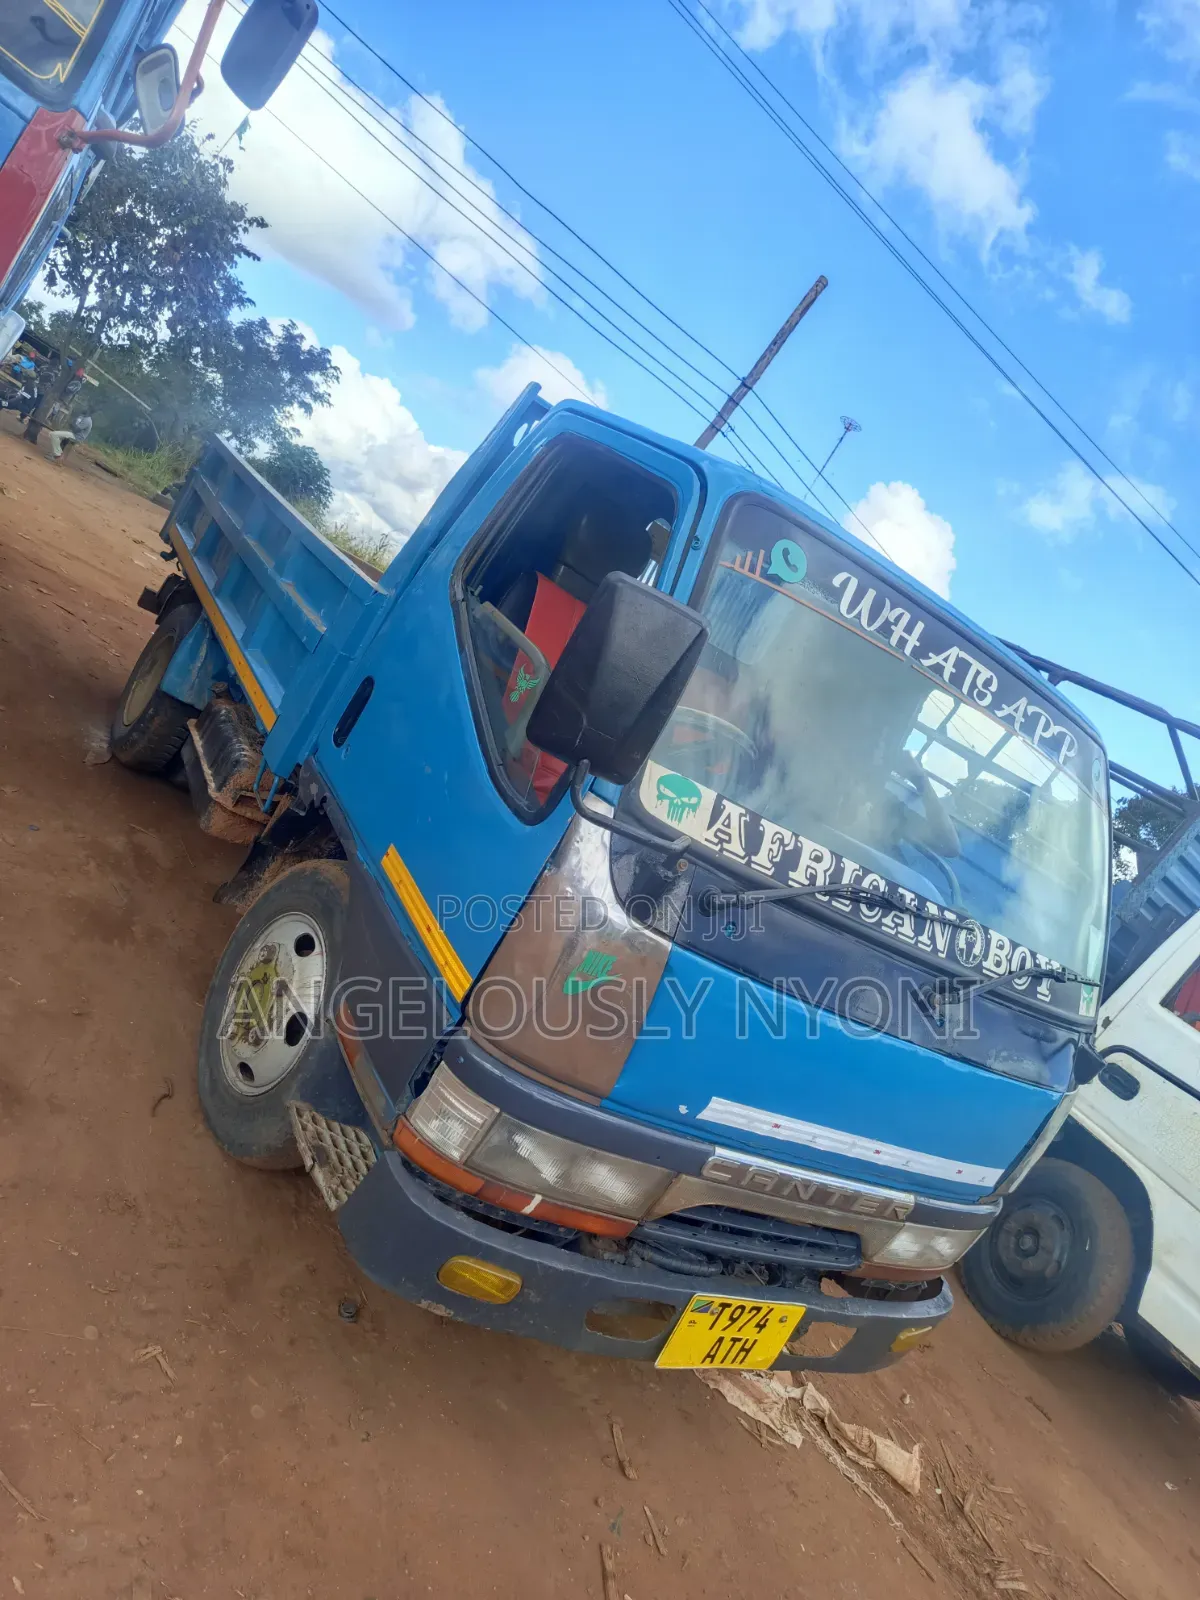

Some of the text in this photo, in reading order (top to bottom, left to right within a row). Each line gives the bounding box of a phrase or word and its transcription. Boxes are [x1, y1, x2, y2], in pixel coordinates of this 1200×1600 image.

[577, 948, 618, 978] NIKE
[701, 1155, 915, 1221] CANTER
[708, 1302, 775, 1335] T974
[700, 1335, 758, 1365] ATH
